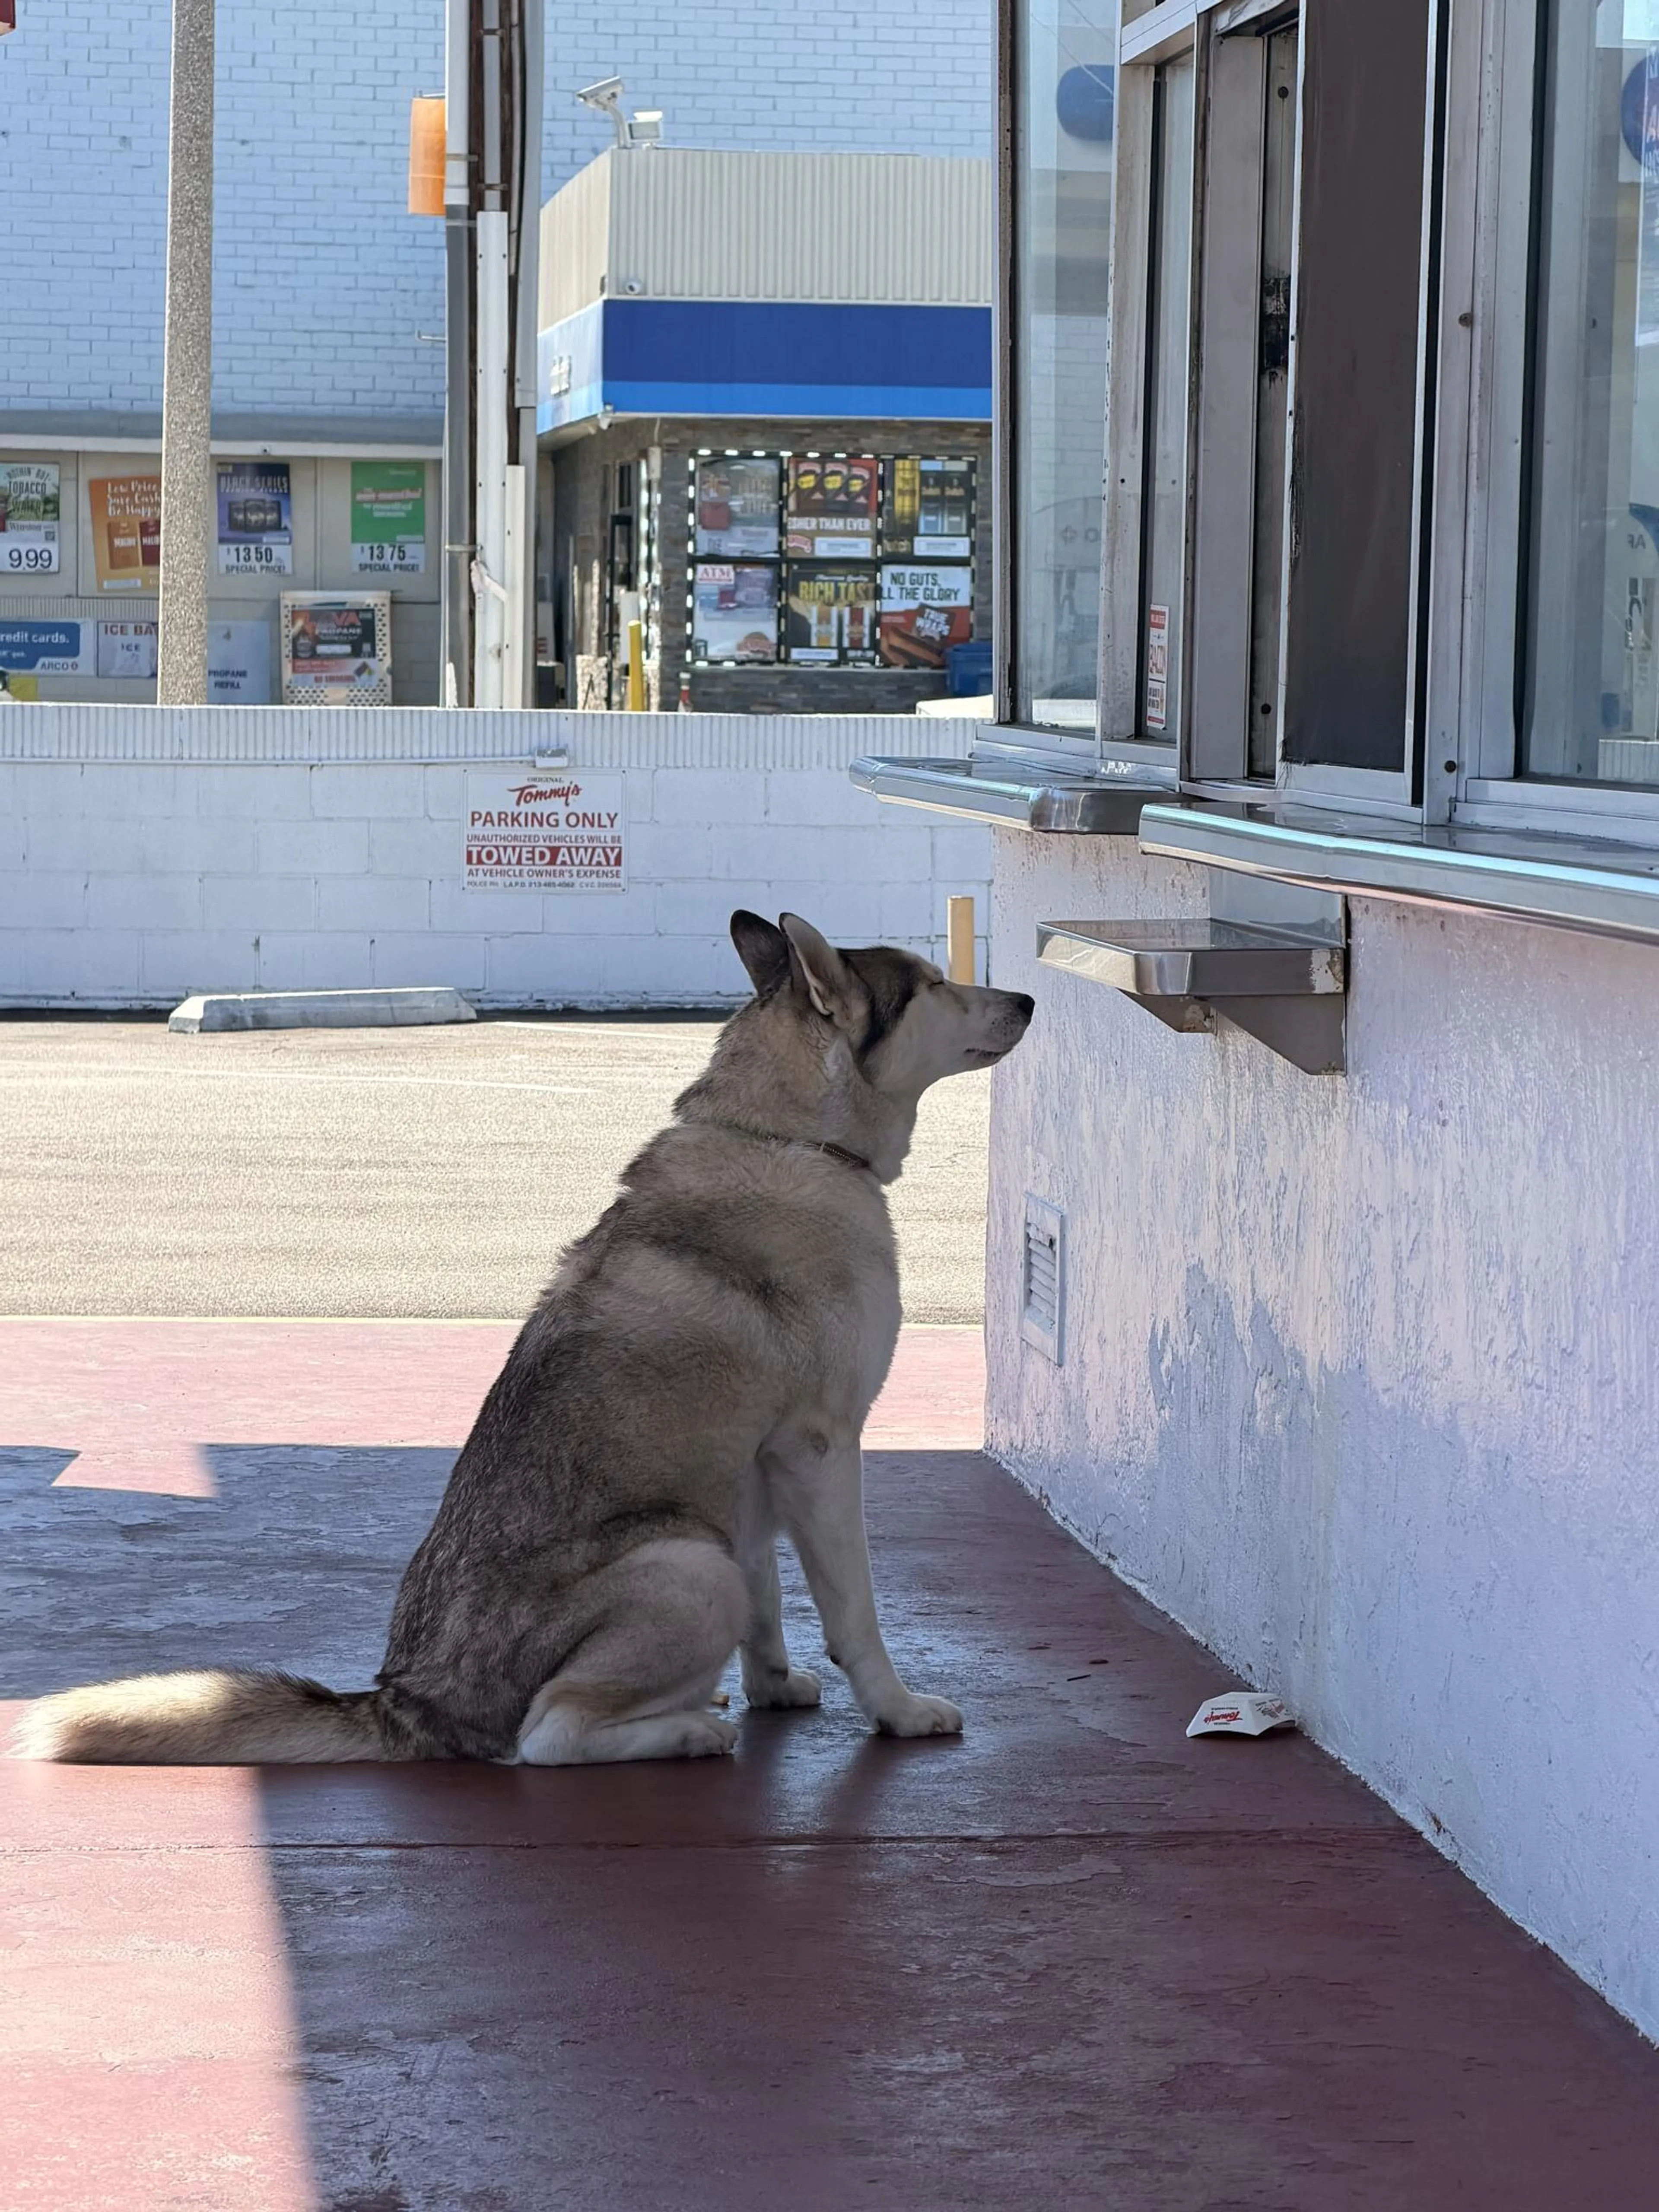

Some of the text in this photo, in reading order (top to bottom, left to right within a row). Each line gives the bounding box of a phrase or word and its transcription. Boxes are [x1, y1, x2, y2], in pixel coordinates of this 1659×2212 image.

[700, 567, 732, 577] ATM
[890, 572, 906, 585] NO
[837, 582, 875, 602] TAST
[899, 587, 920, 600] THE
[922, 588, 960, 601] GLORY
[0, 631, 29, 642] redit
[105, 624, 129, 636] ICE
[507, 781, 583, 807] Tommy's
[470, 811, 618, 828] PARKING ONLY
[467, 834, 622, 844] UNAUTHORIZED VEHICLES WILL BE
[467, 846, 620, 865] TOWED AWAY
[467, 868, 621, 879] AT VEHICLE OWNER'S EXPENSE
